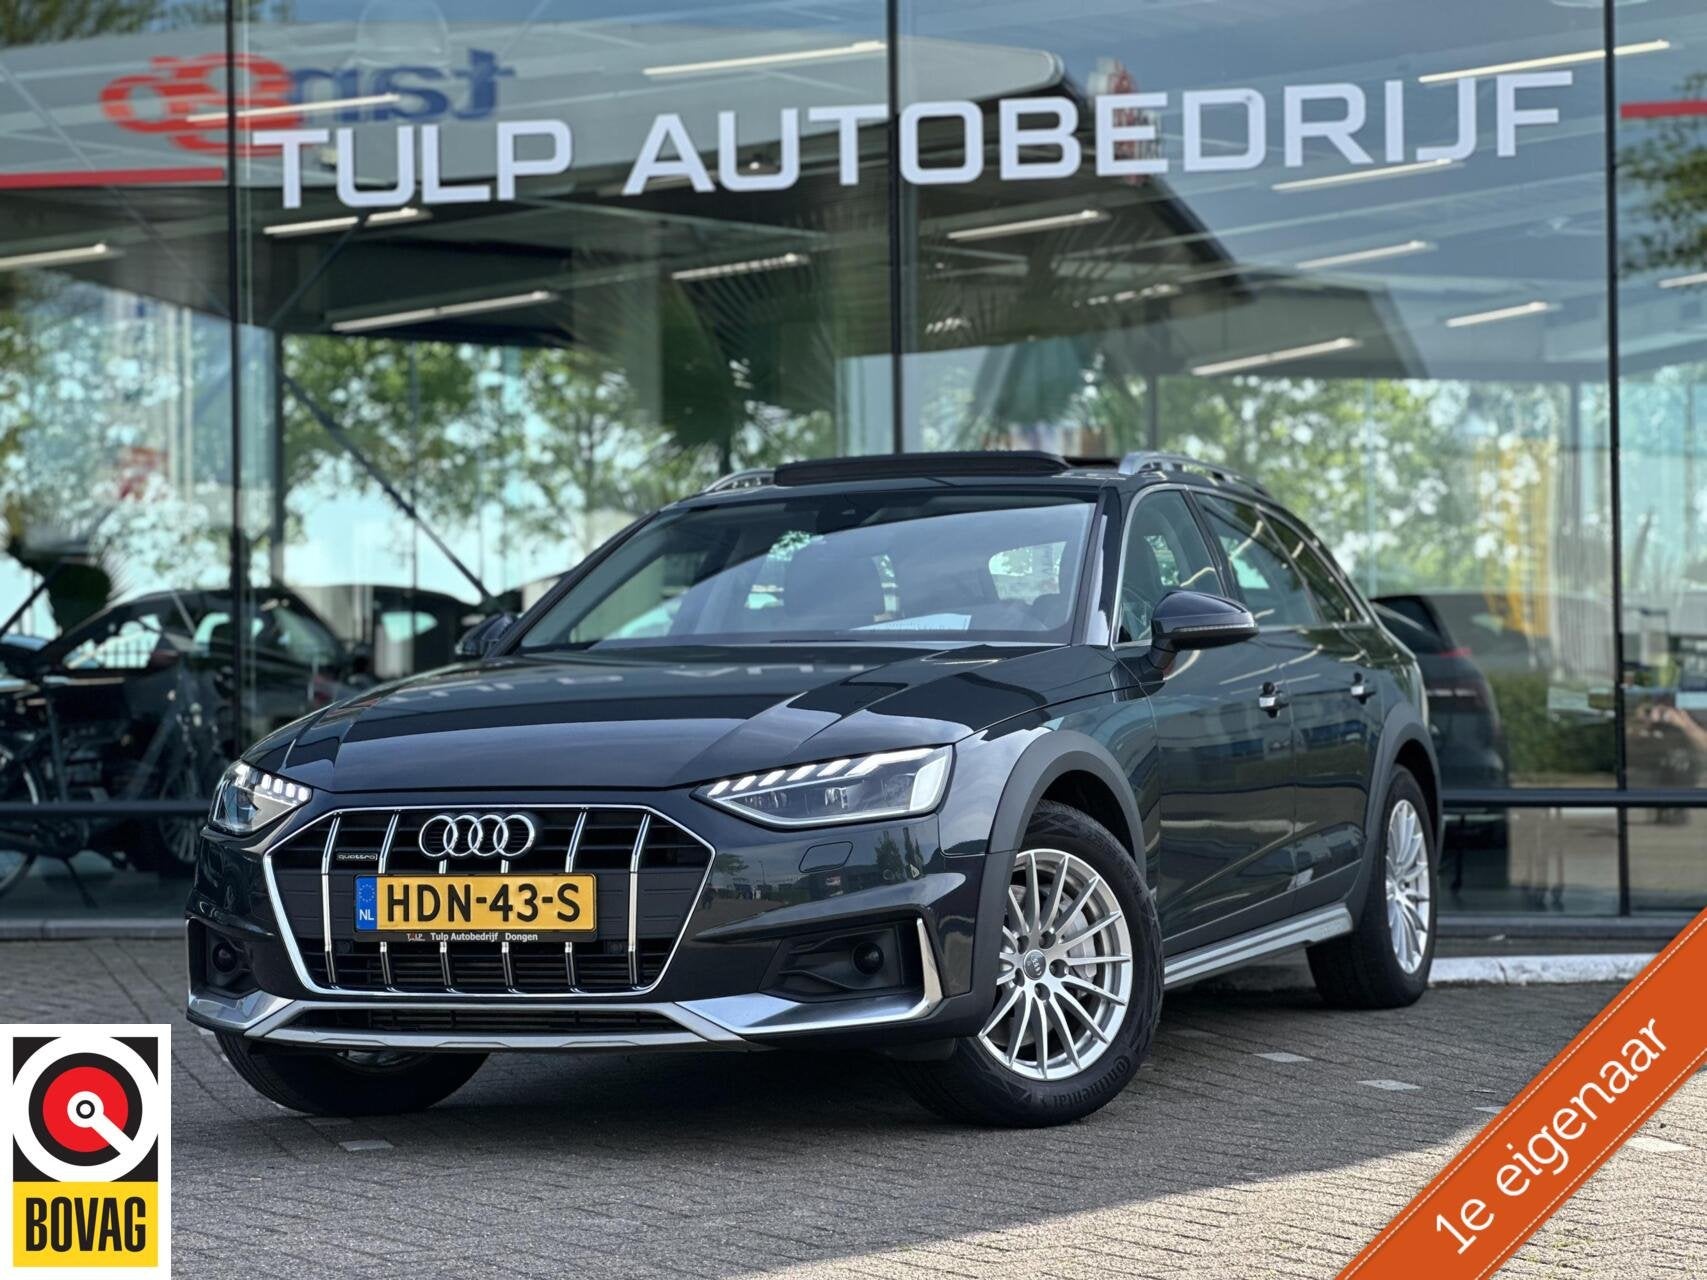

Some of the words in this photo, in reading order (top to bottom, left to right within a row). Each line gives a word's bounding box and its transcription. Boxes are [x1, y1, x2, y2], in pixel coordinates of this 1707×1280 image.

[252, 119, 573, 209] TULP
[622, 71, 1574, 197] AUTOBEDRIJF
[359, 909, 375, 921] NL
[387, 883, 581, 922] HDN-43-S
[430, 932, 449, 942] Tulp
[451, 932, 499, 942] Autobedrijf
[505, 932, 538, 942] Dongen
